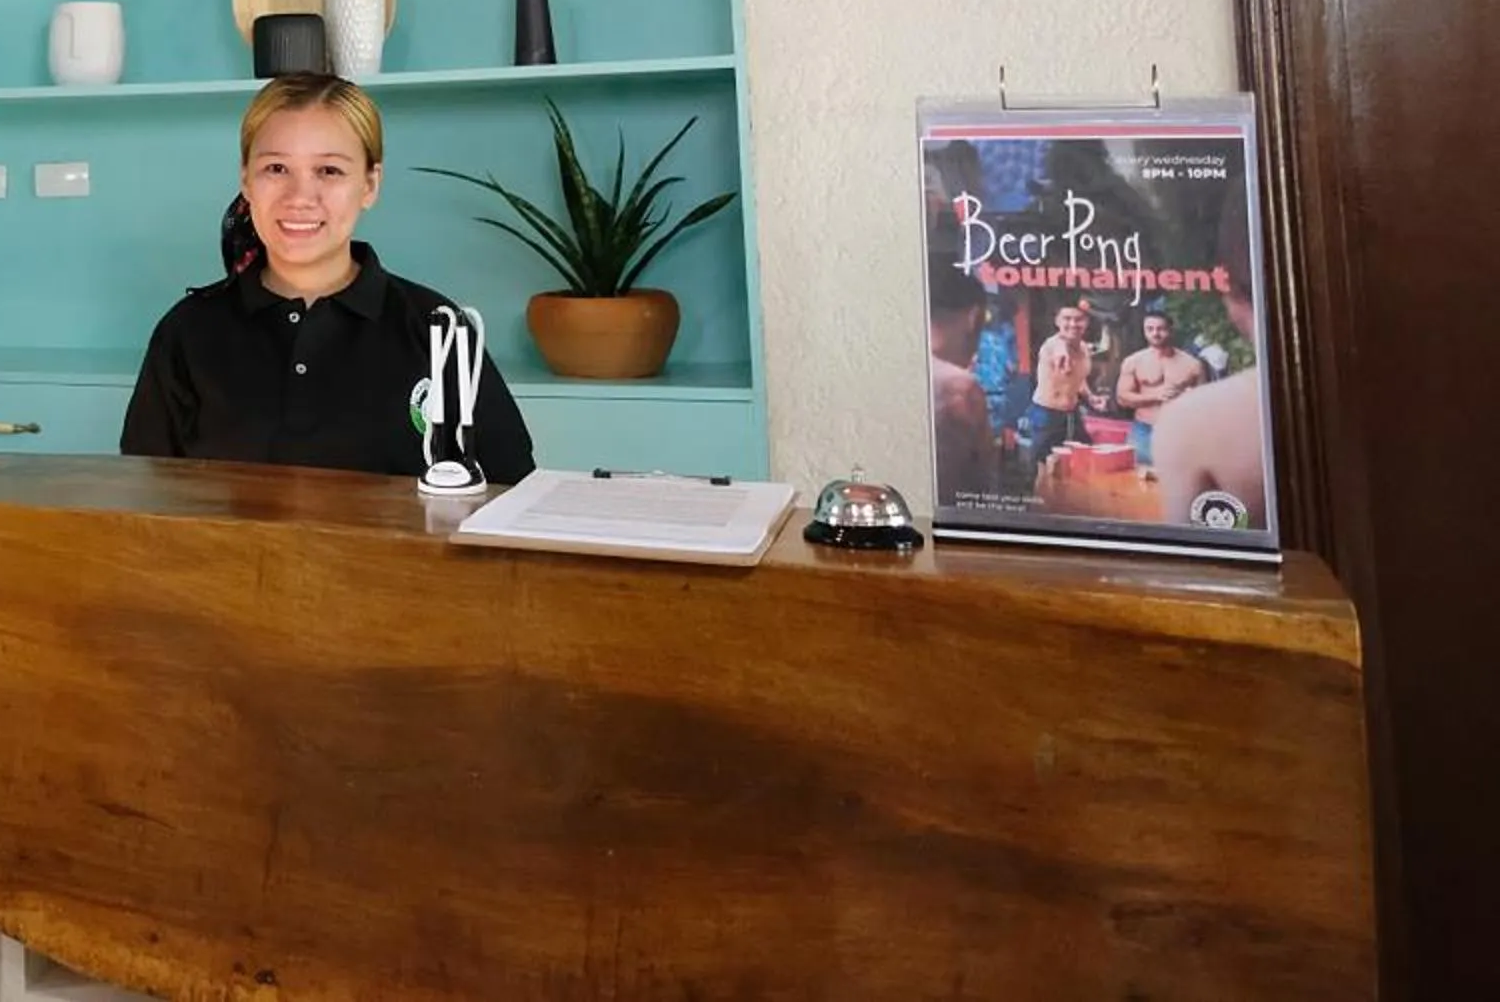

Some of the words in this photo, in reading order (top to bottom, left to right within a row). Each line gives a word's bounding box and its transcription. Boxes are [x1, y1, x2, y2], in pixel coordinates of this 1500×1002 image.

[1187, 168, 1227, 179] 10PM
[952, 191, 1054, 275] Beer
[1062, 189, 1141, 307] Pong
[978, 261, 1231, 292] tournament
